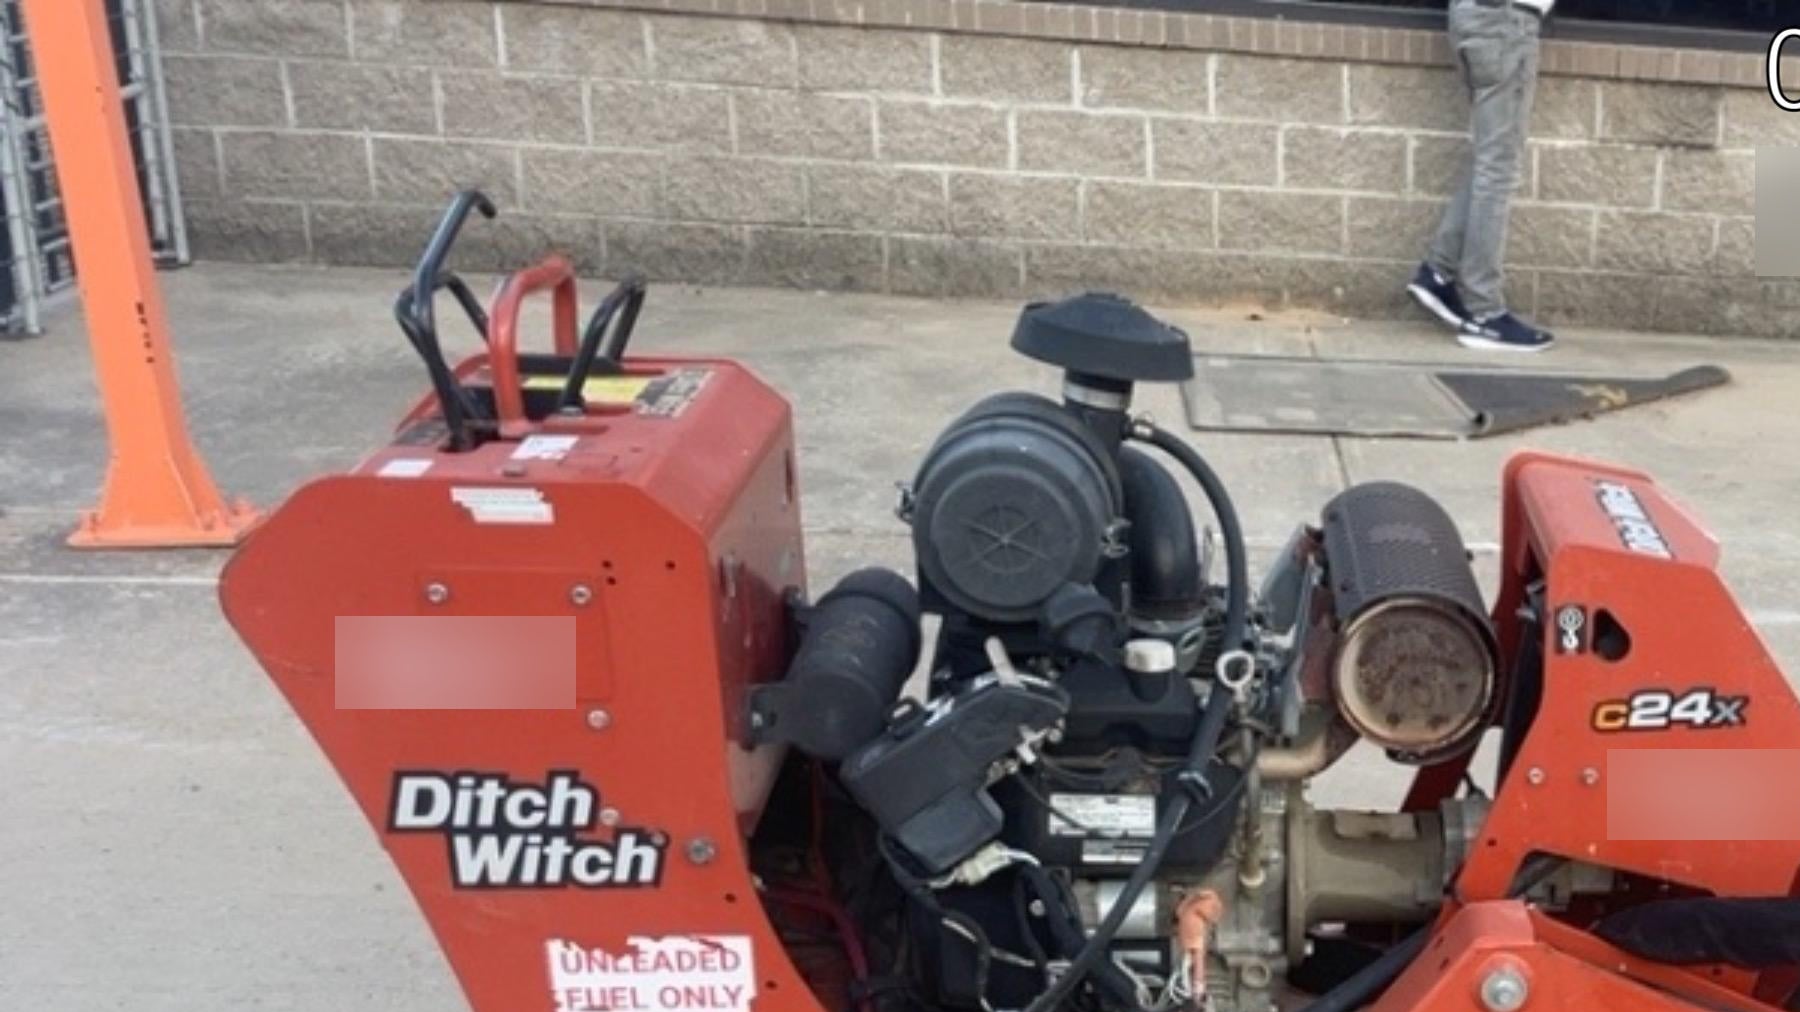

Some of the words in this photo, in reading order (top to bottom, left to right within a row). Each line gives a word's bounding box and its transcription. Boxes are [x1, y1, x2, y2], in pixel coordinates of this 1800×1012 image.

[394, 775, 593, 829] Ditch
[453, 833, 660, 884] Witch
[560, 949, 742, 974] UNLEADED
[565, 986, 649, 1012] FUEL
[658, 985, 744, 1009] ONLY
